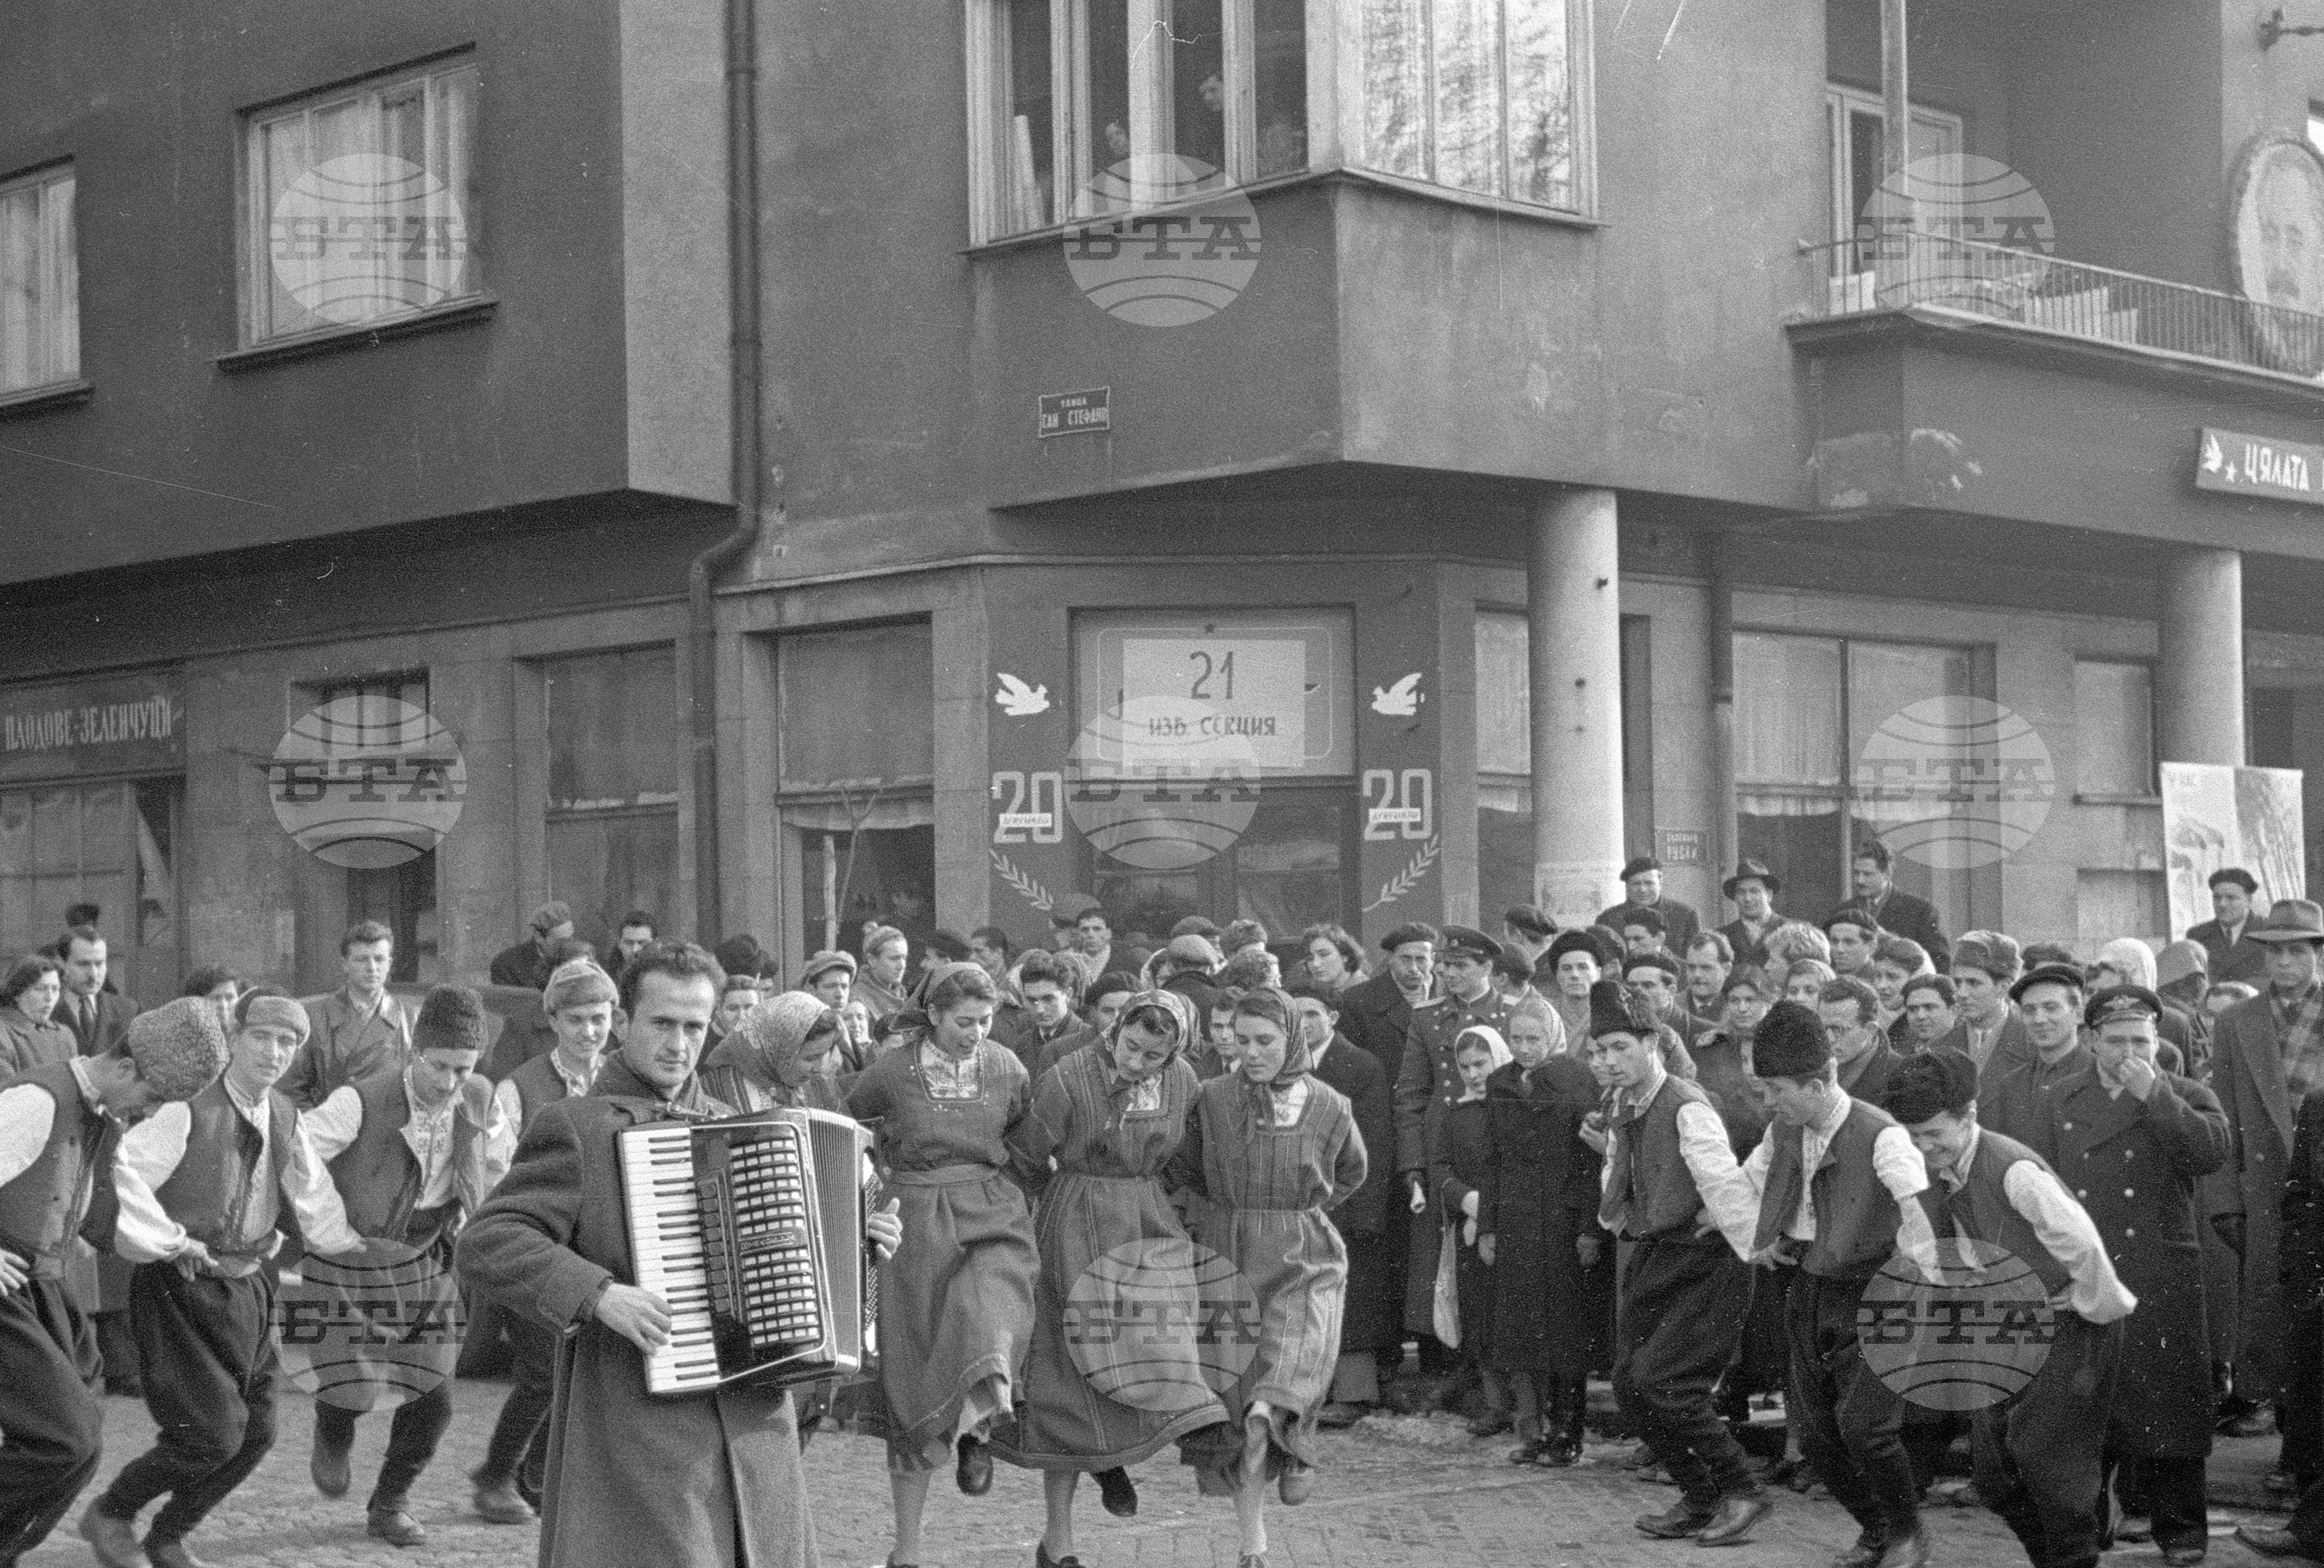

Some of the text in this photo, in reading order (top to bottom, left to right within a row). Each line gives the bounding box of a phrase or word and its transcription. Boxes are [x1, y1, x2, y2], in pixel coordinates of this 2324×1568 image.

[2244, 443, 2309, 491] ЦЯЛАТА
[1189, 651, 1234, 699] 21
[1200, 715, 1276, 736] СЕКЦИЯ
[992, 771, 1063, 844] 20
[1362, 769, 1432, 841] 20
